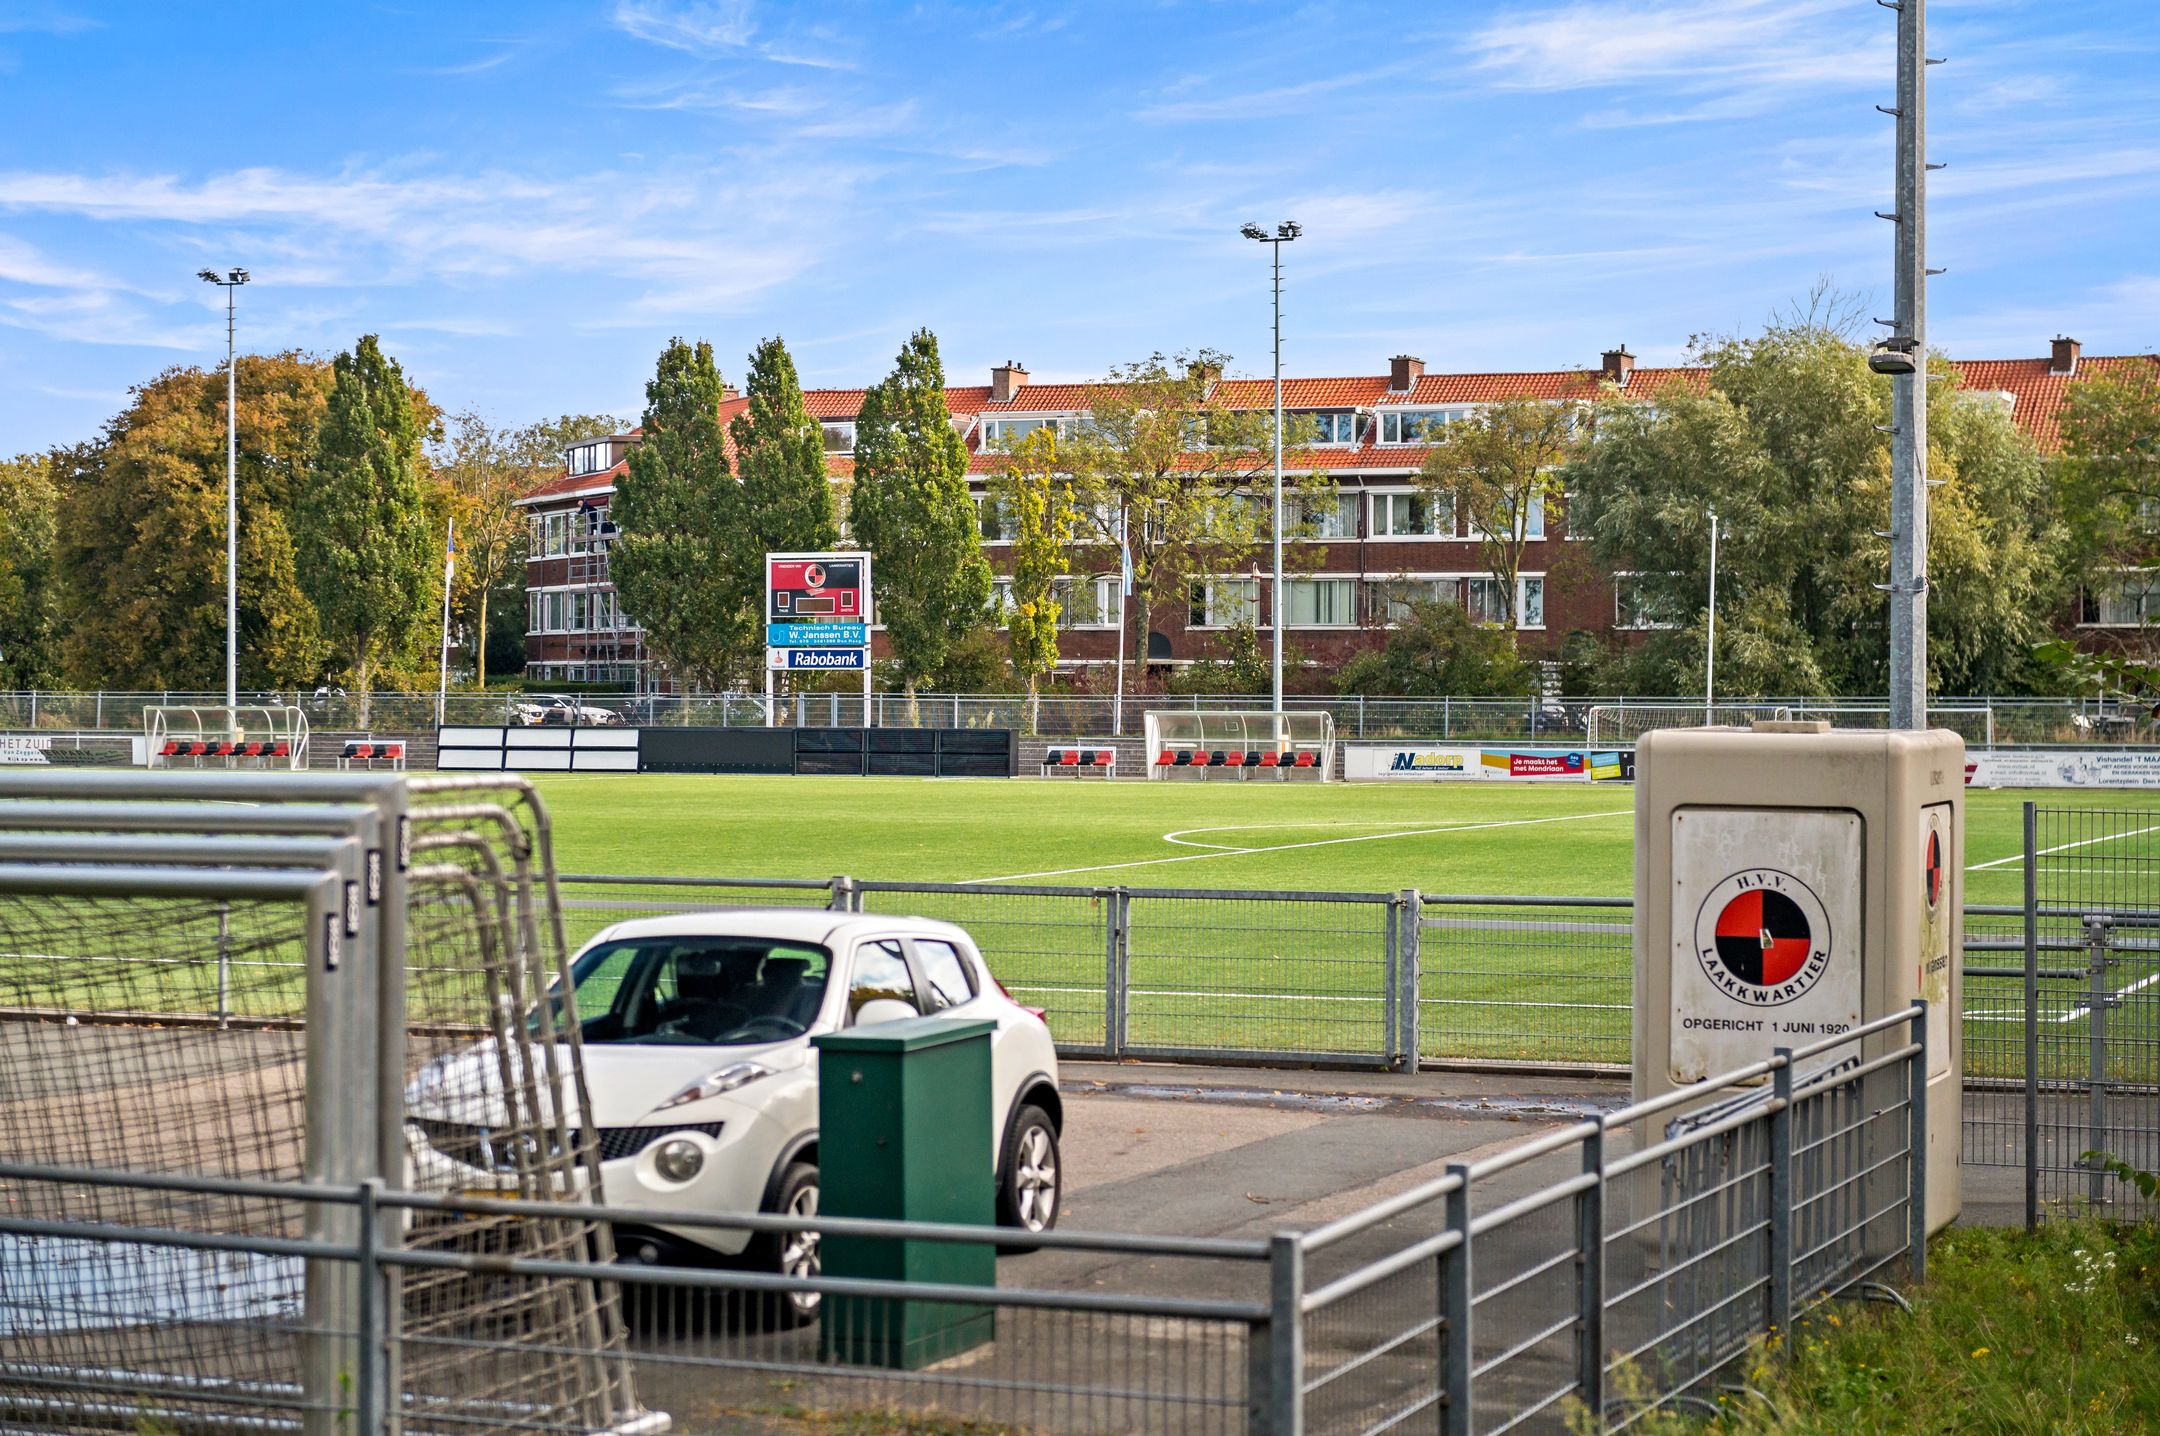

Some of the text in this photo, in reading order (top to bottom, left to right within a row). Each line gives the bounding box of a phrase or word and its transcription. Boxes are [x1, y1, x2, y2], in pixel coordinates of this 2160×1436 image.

[789, 631, 800, 639] W.
[803, 631, 841, 639] Janssen
[795, 651, 857, 666] Rabobank
[1394, 752, 1464, 770] Nadorp
[1736, 873, 1787, 892] H.V.V.
[1702, 947, 1827, 1003] LAAKKWARTIER
[1682, 1017, 1850, 1035] OPGERICHT 1 JUNI 1920
